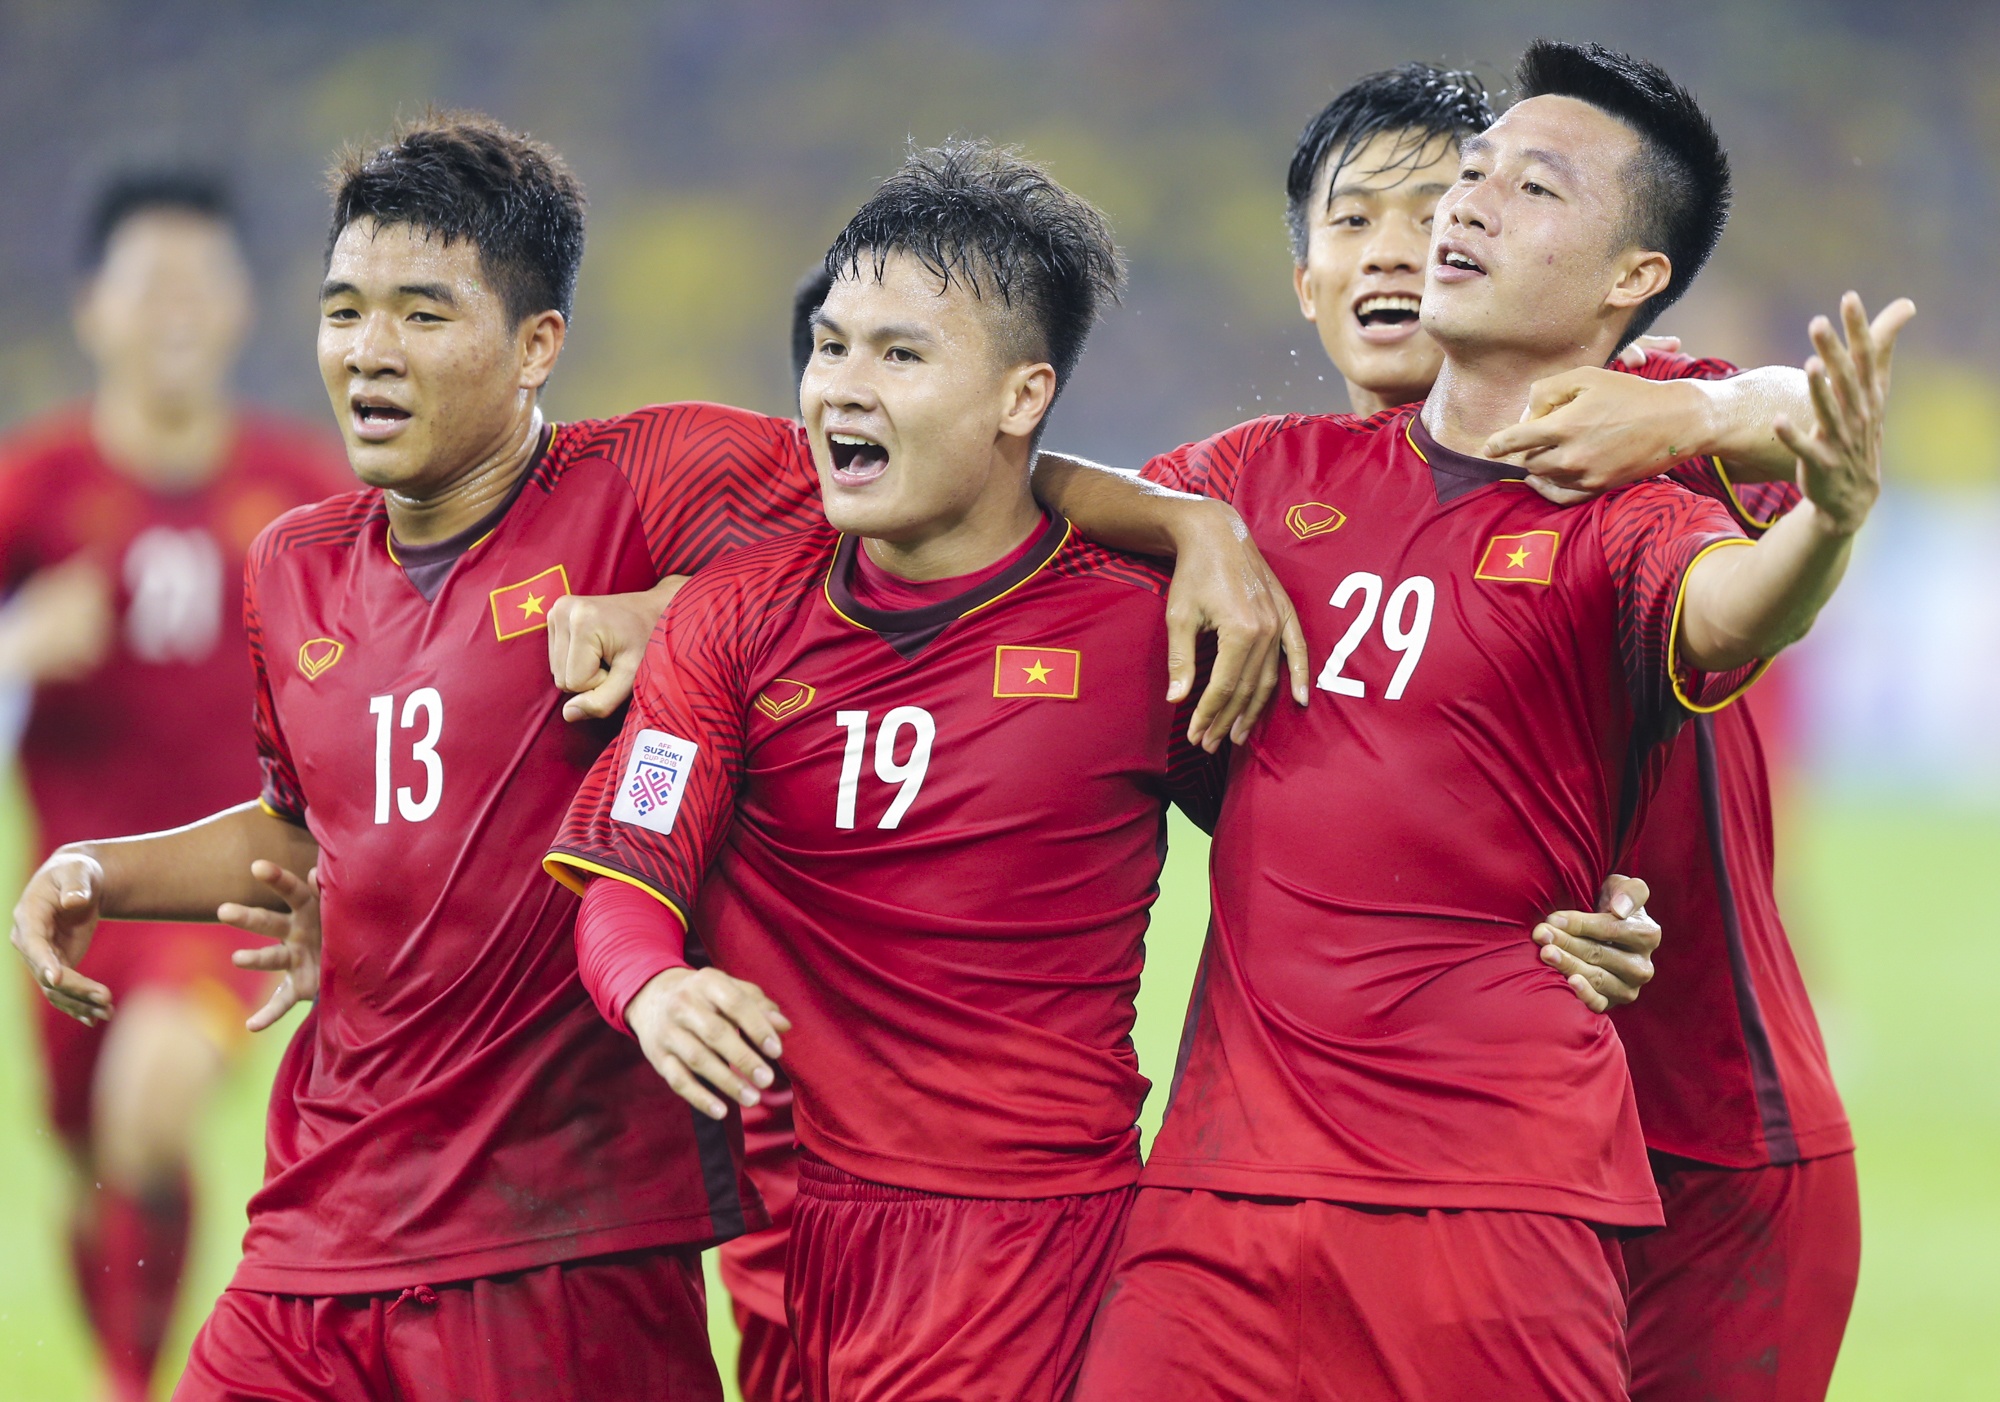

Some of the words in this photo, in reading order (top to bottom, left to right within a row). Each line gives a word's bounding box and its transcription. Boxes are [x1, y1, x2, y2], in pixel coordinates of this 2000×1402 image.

[1316, 572, 1435, 699] 29
[369, 687, 443, 824] 13
[643, 745, 683, 762] SUZUKI
[643, 753, 659, 761] CUP
[659, 757, 677, 768] 2018
[658, 742, 672, 750] AFF
[836, 706, 936, 829] 19
